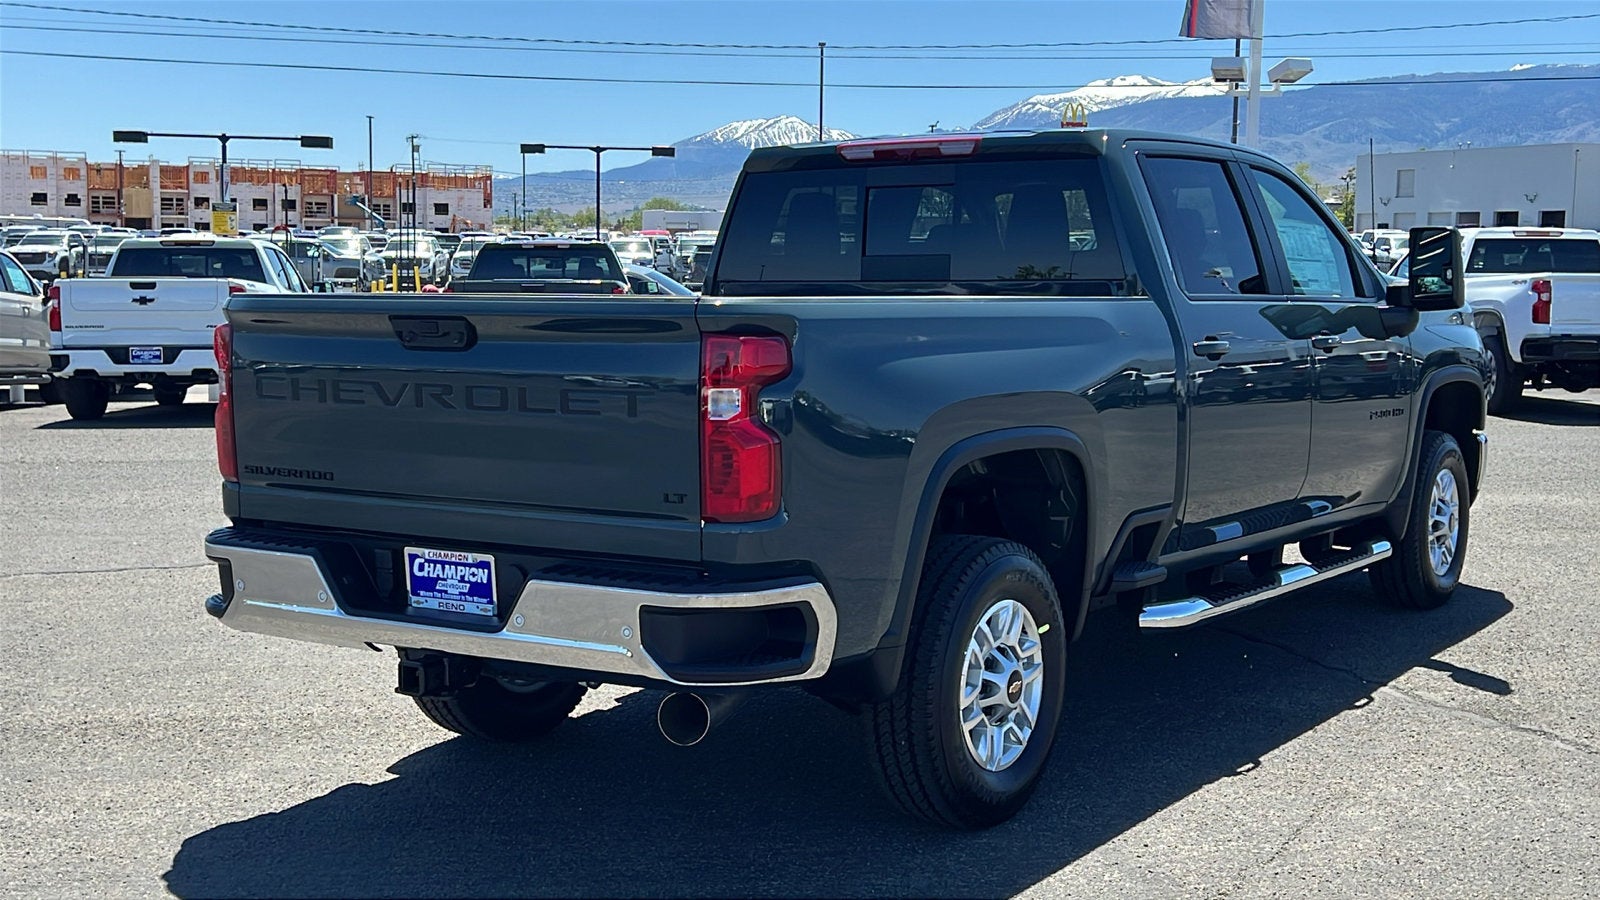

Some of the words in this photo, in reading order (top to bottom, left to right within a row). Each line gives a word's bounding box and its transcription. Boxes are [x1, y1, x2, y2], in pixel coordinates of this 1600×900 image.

[256, 375, 654, 418] CHEVROLET
[244, 464, 335, 481] SILVERADO
[663, 492, 688, 504] LT
[427, 550, 469, 562] CHAMPION
[413, 558, 488, 583] CHAMPION
[438, 582, 467, 590] CHEVROLET
[438, 602, 465, 611] RENO
